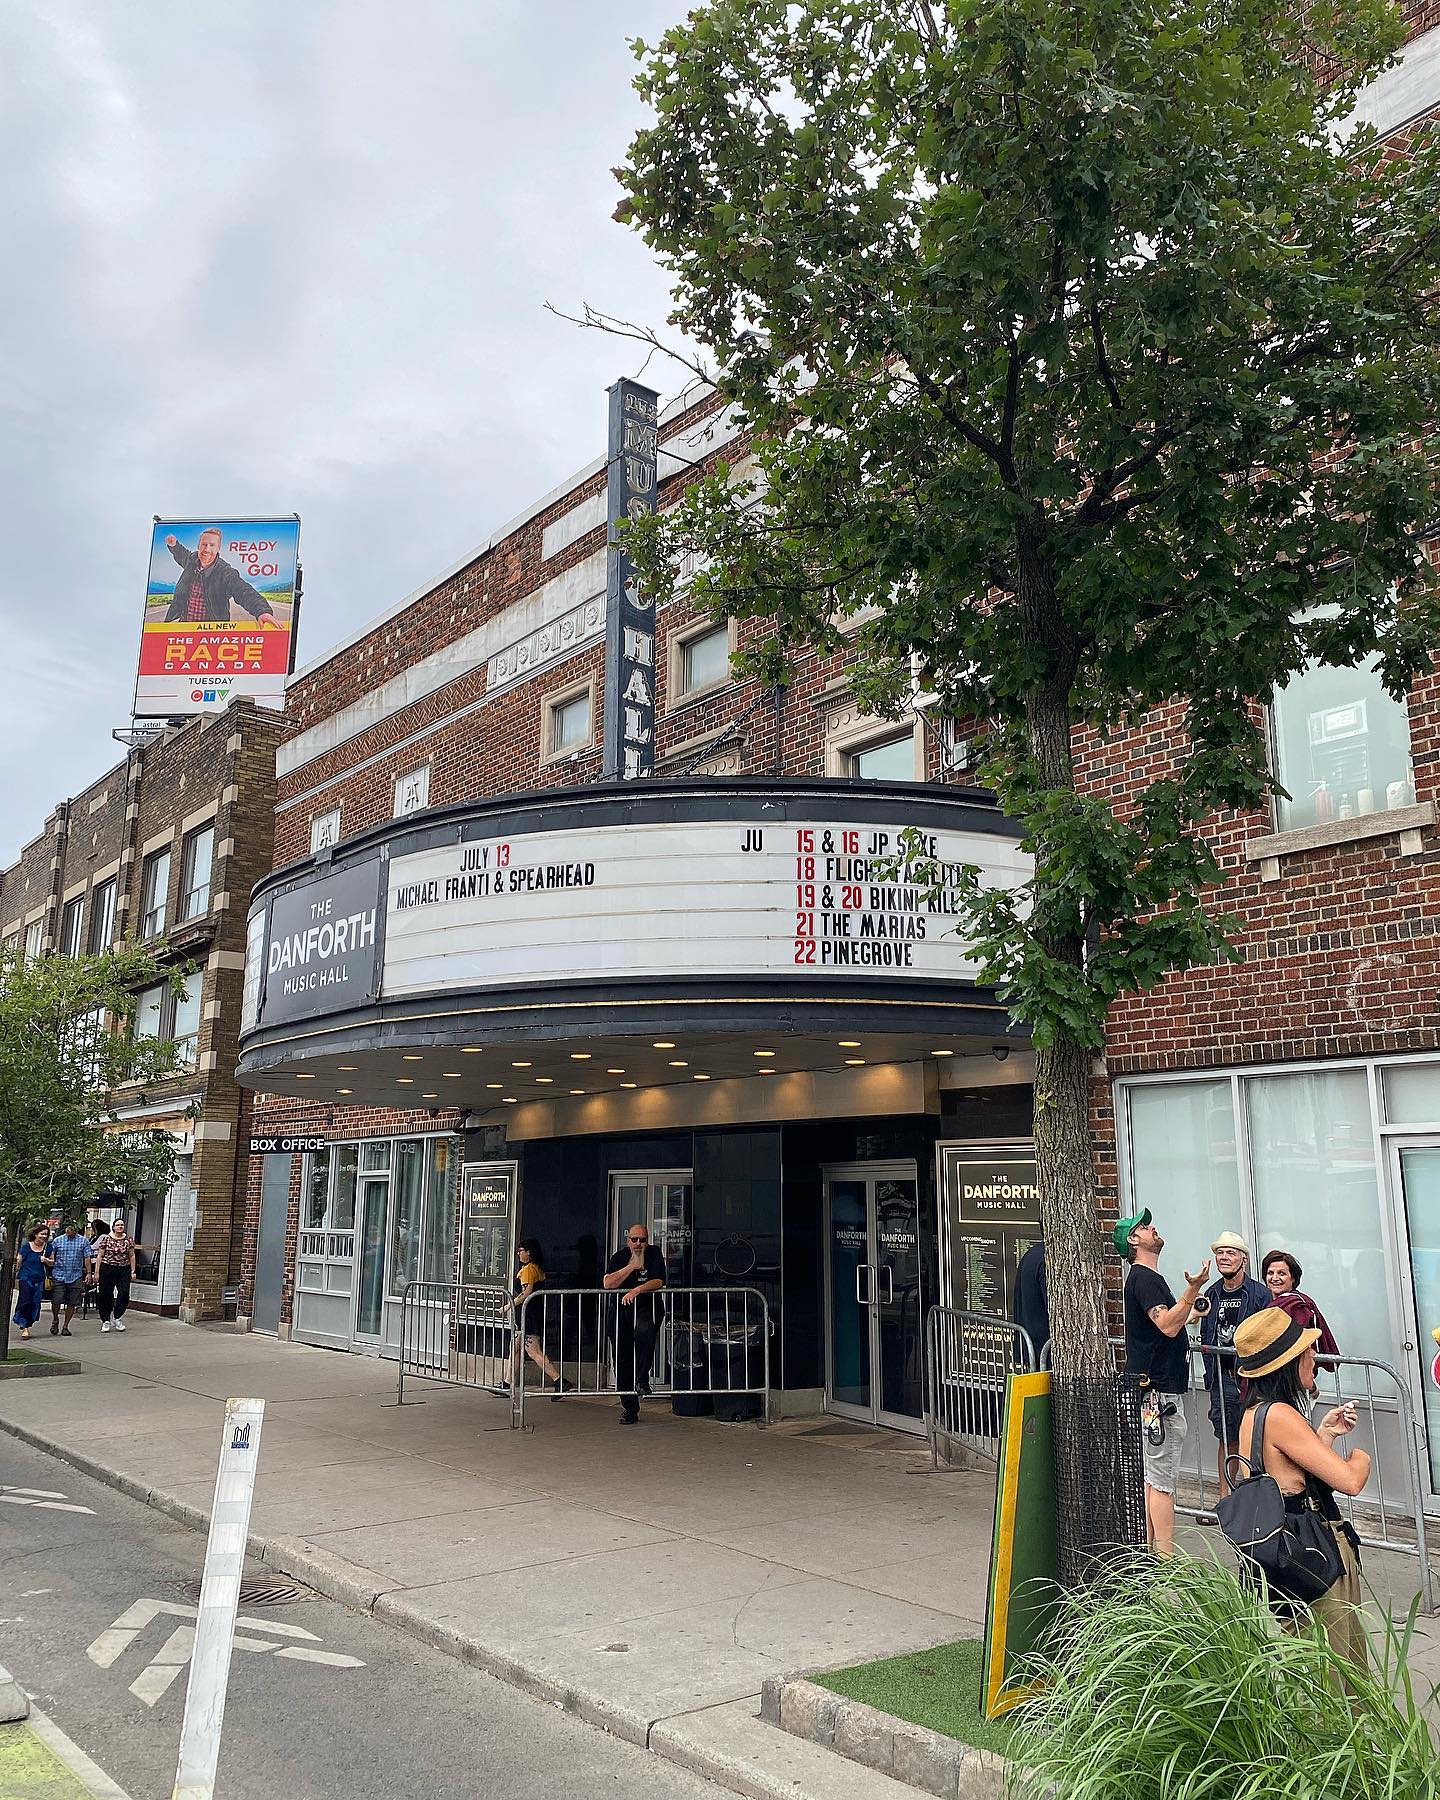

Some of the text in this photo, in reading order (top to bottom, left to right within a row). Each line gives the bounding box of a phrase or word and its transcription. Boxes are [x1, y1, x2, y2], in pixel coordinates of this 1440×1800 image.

[624, 418, 658, 611] MUSC
[229, 541, 277, 551] READY
[239, 553, 258, 563] TO
[248, 564, 278, 576] GO!
[168, 636, 264, 645] THE AMAZING
[165, 644, 263, 662] RACE
[164, 661, 261, 670] CANADA
[189, 677, 234, 685] TUESDAY
[191, 689, 230, 702] CTV
[741, 829, 763, 852] JU
[796, 829, 814, 853] 15
[822, 829, 835, 854] &
[842, 831, 859, 855] 16
[867, 832, 889, 856] JP
[460, 843, 511, 872] JULY 13
[796, 857, 815, 881] 18
[396, 862, 595, 910] MICHAEL FRANTI & SPEARHEAD
[796, 884, 815, 909] 19
[822, 885, 835, 909] &
[841, 885, 863, 909] 20
[311, 898, 332, 920] THE
[795, 912, 926, 939] 21 THE MARIAS
[268, 907, 376, 975] DANFORTH
[794, 940, 913, 967] 22 PINEGROVE
[283, 963, 349, 996] MUSIC HALL
[250, 1138, 325, 1151] BOX OFFICE
[472, 1192, 506, 1202] DANFORTH
[964, 1185, 1040, 1199] DANFORTH
[836, 1231, 867, 1240] DANFORTH
[881, 1233, 915, 1243] DANFORTH
